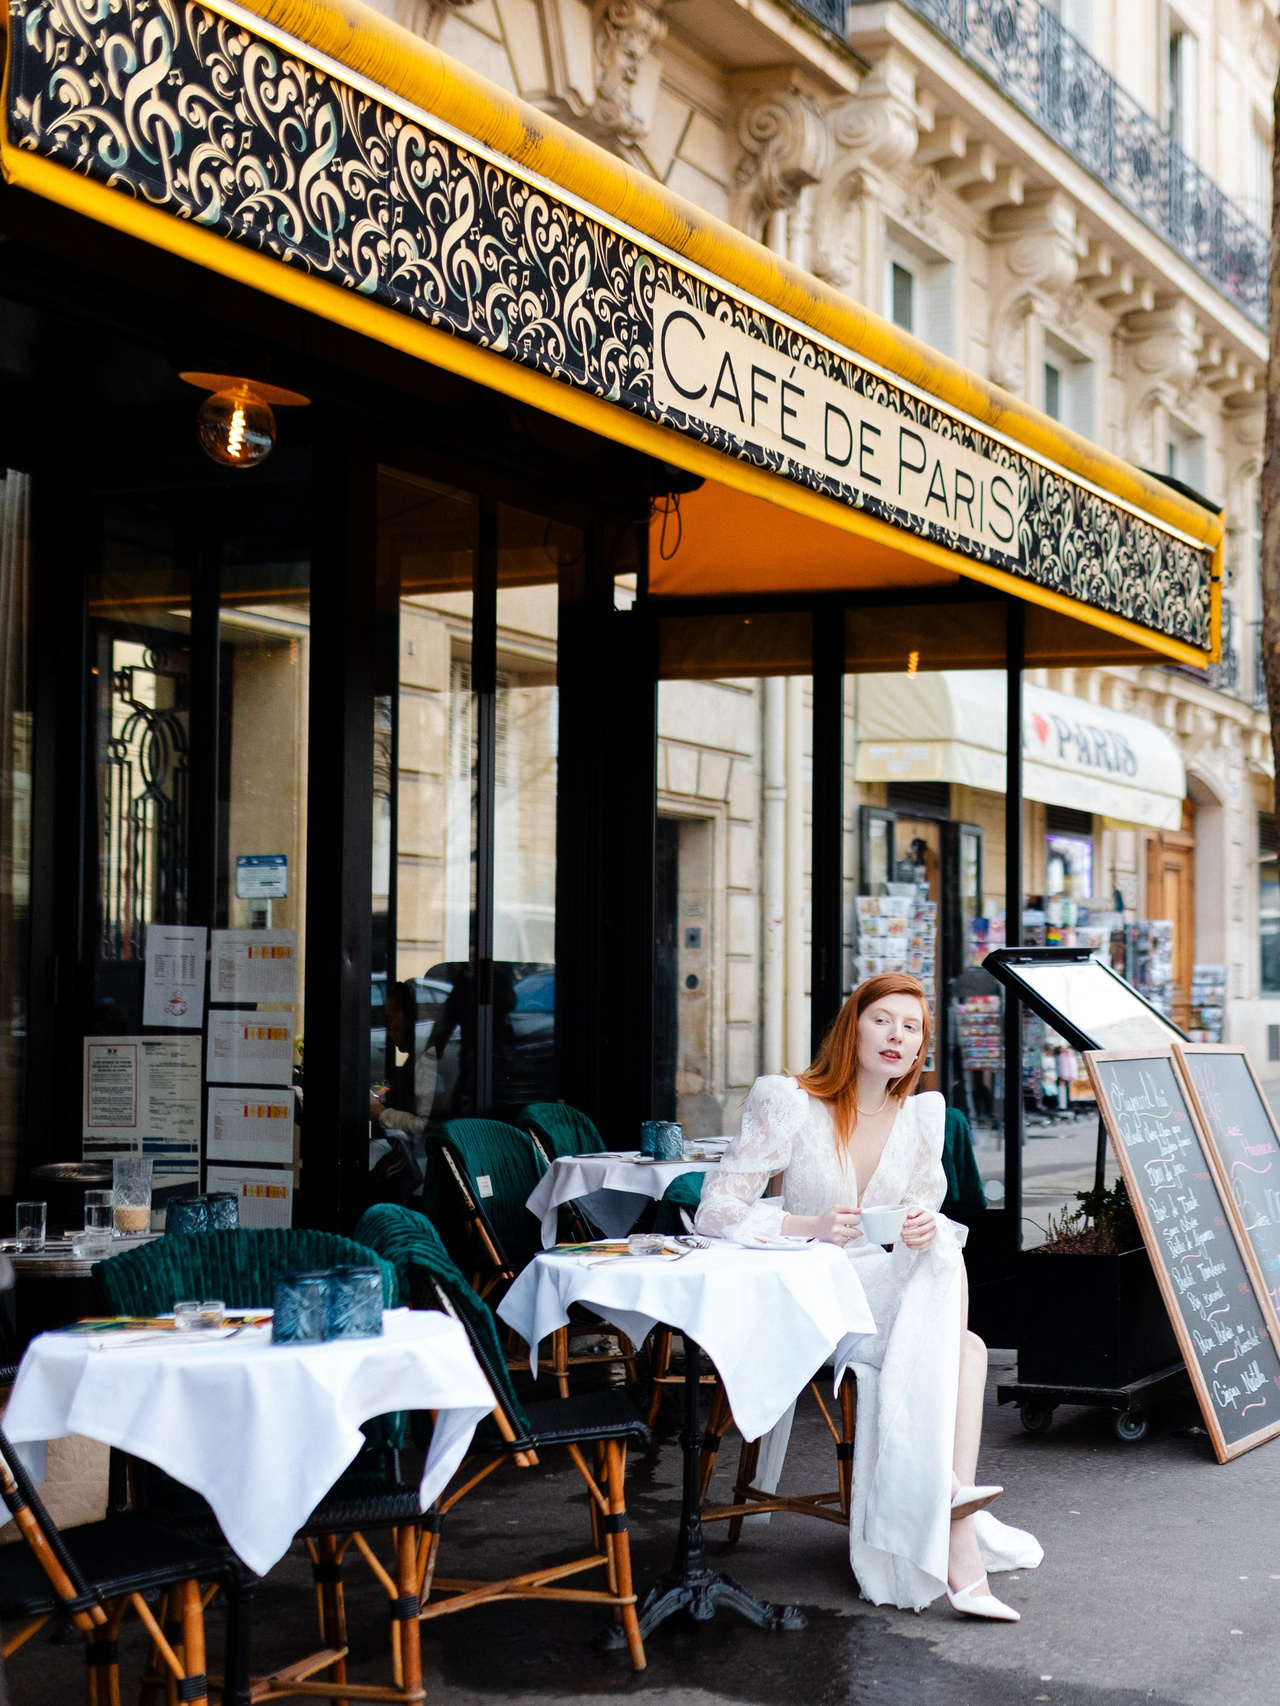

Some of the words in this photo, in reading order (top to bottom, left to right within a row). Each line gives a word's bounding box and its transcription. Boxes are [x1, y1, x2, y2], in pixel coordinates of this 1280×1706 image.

[660, 309, 807, 450] CAFÉ
[824, 402, 883, 489] DE
[898, 425, 1021, 545] PARIS
[1047, 713, 1138, 778] PARIS
